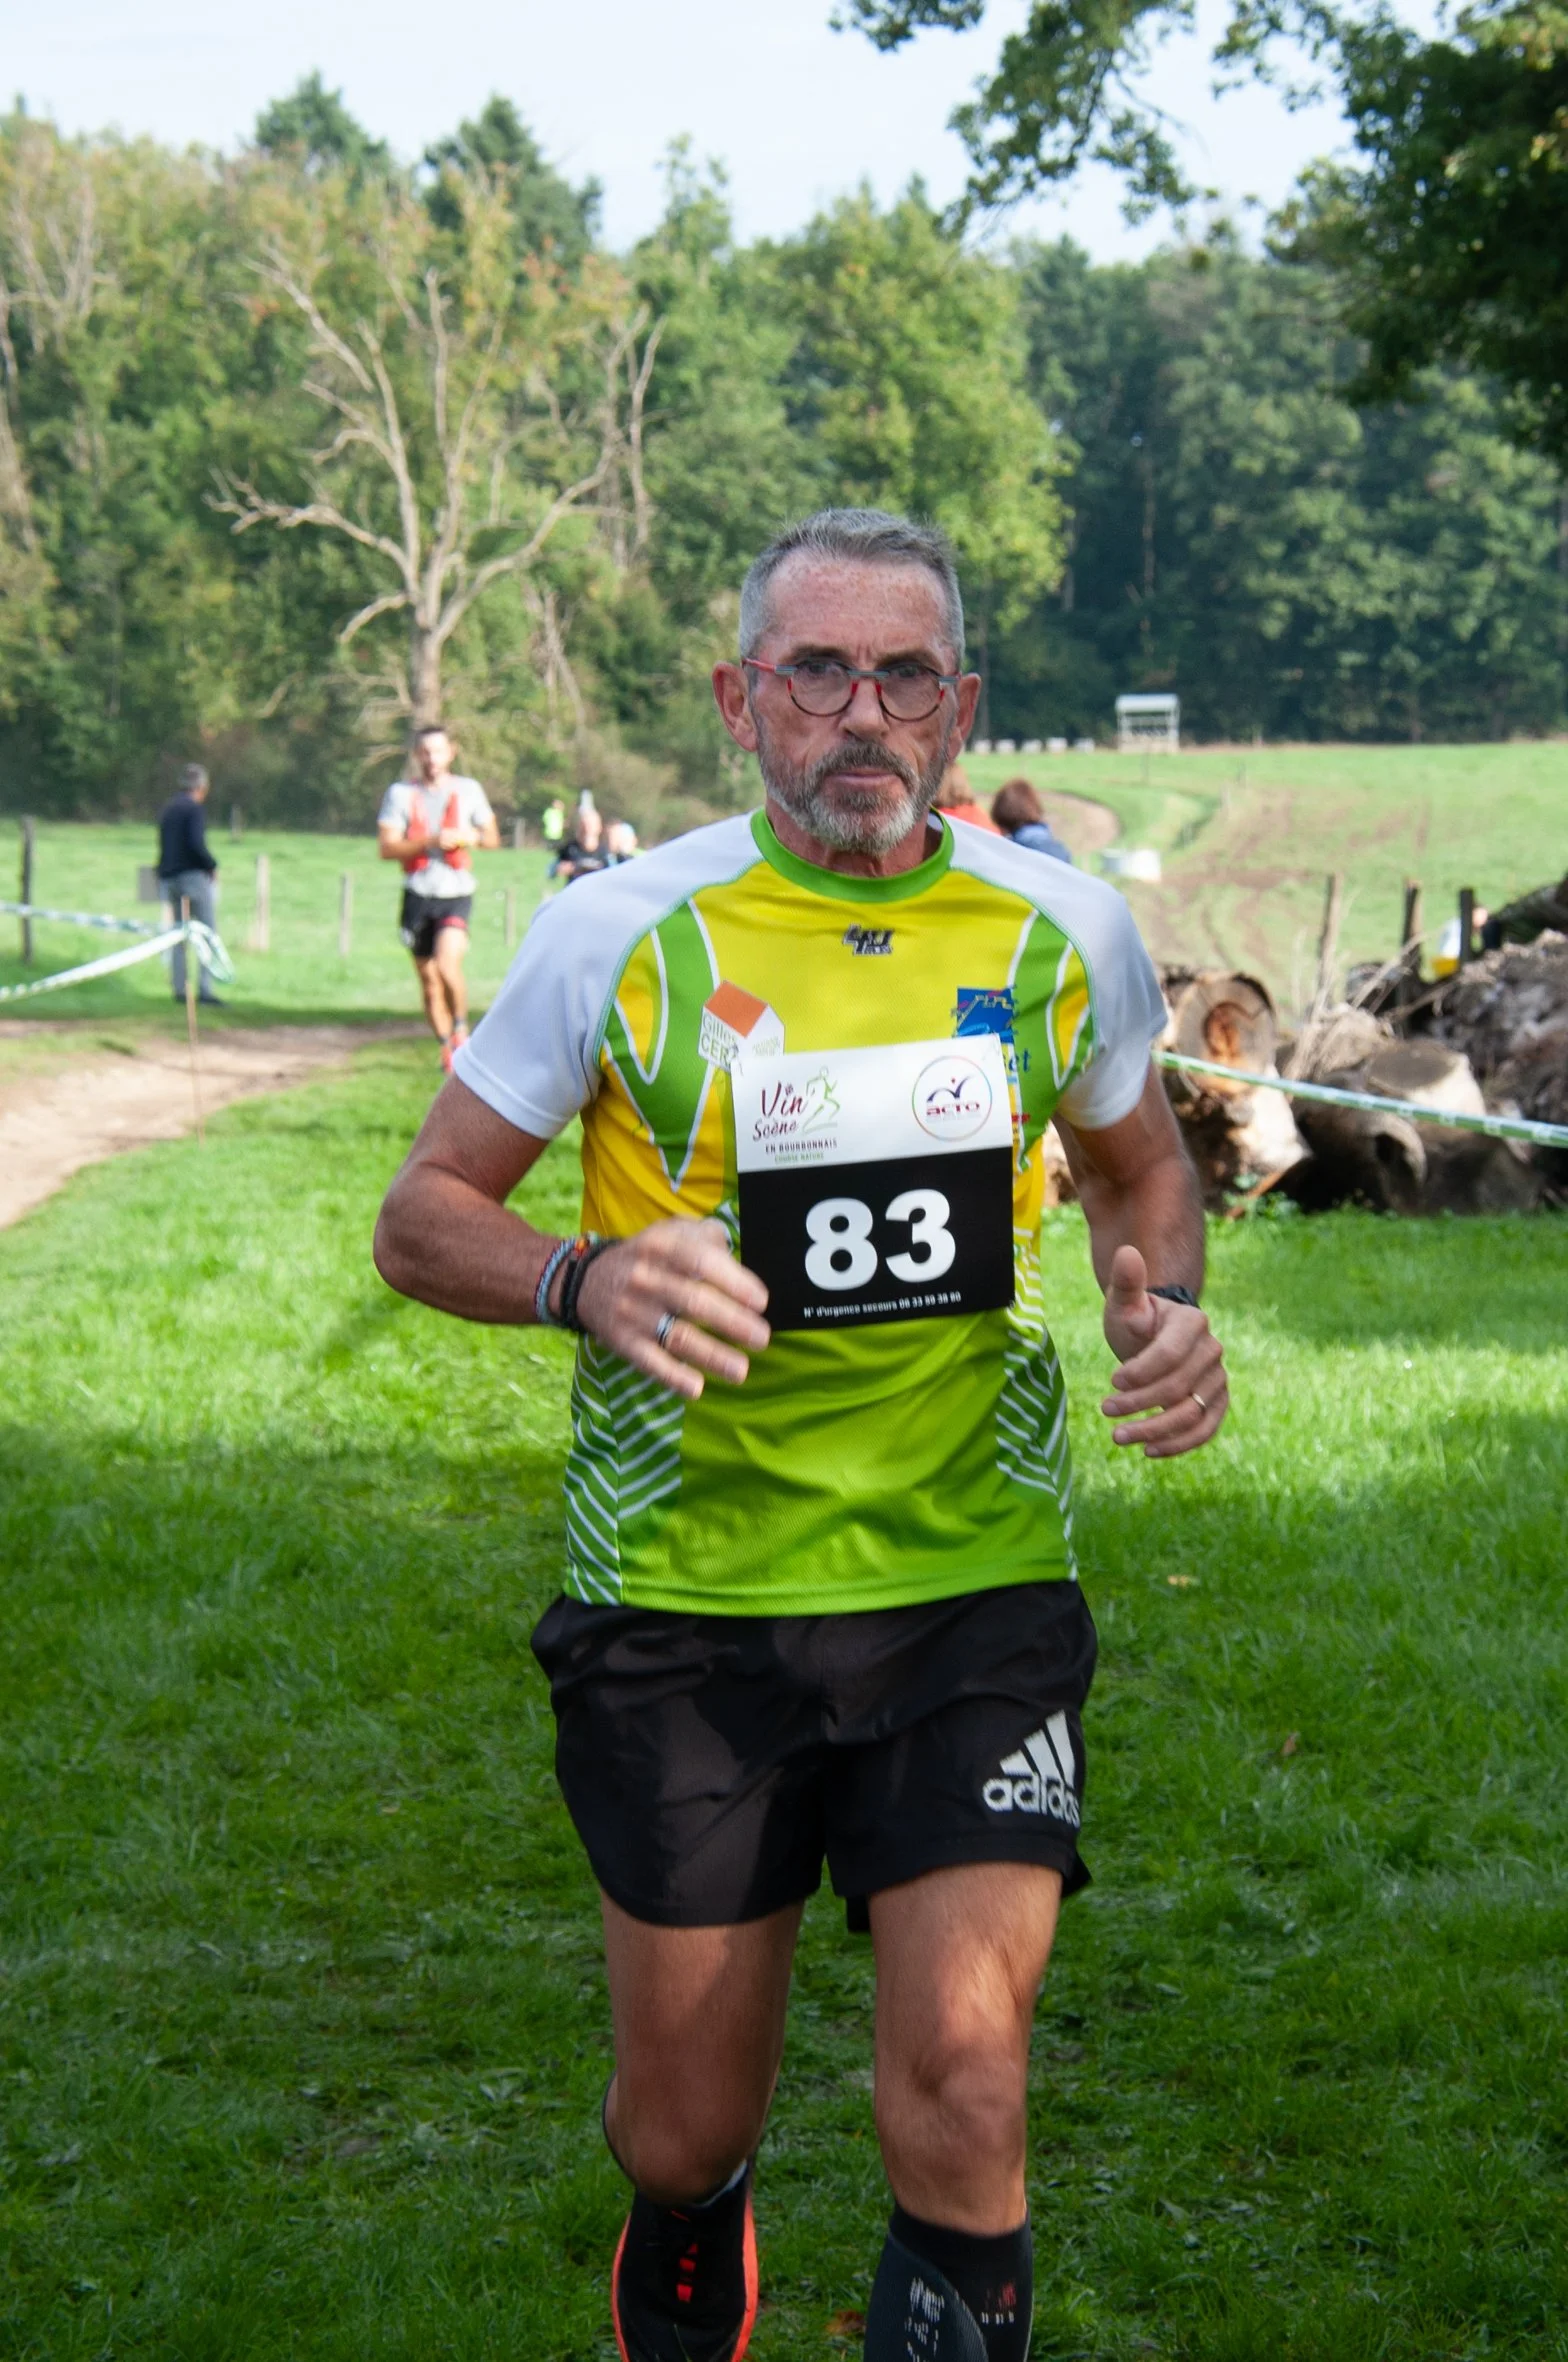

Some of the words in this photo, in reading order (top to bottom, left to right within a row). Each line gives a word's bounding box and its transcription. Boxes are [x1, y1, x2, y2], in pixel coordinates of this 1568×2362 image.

[761, 1080, 803, 1118] Vin
[752, 1118, 799, 1142] Scène
[765, 1143, 776, 1155] EN
[779, 1137, 837, 1153] BOURBONNAIS
[804, 1188, 956, 1291] 83
[982, 1773, 1080, 1828] adidas
